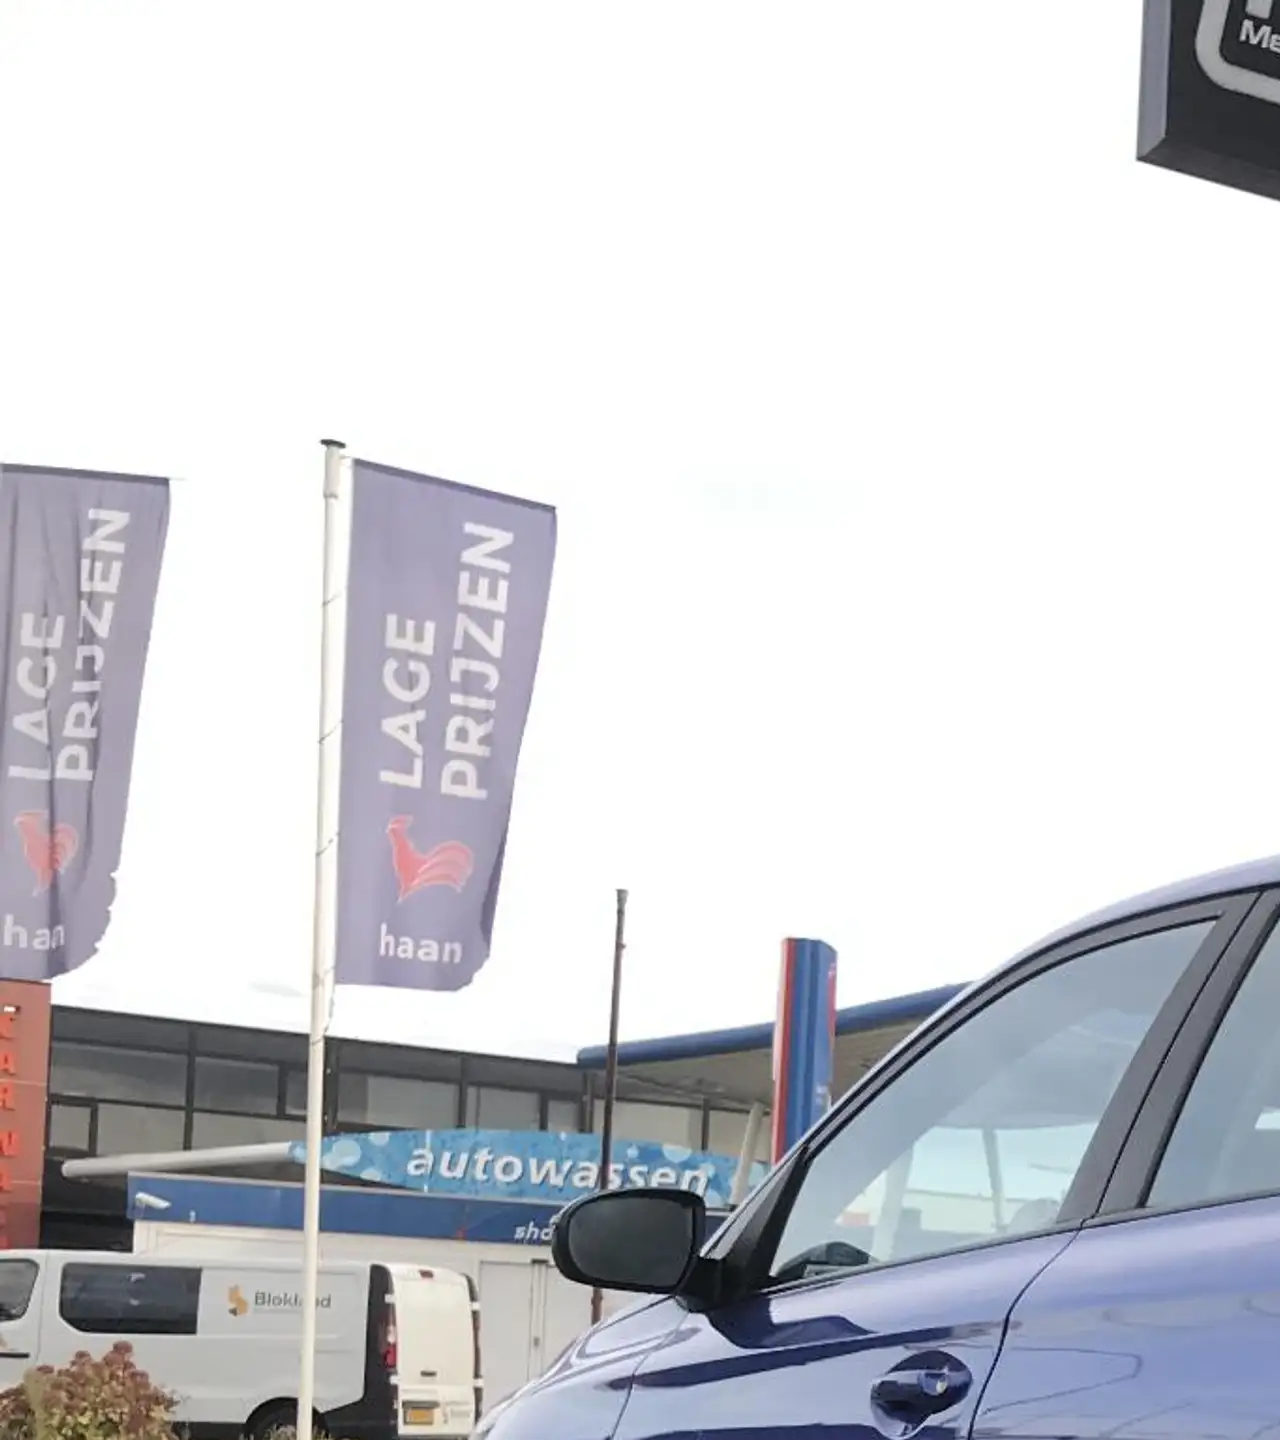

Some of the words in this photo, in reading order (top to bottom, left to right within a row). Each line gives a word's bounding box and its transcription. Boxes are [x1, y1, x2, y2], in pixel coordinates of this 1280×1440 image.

[54, 508, 130, 781] PRIJZEN
[379, 613, 436, 789] LAGE
[441, 522, 515, 800] PRIJZEN
[379, 922, 463, 965] haan
[406, 1145, 712, 1196] autowassen
[514, 1219, 554, 1242] sho
